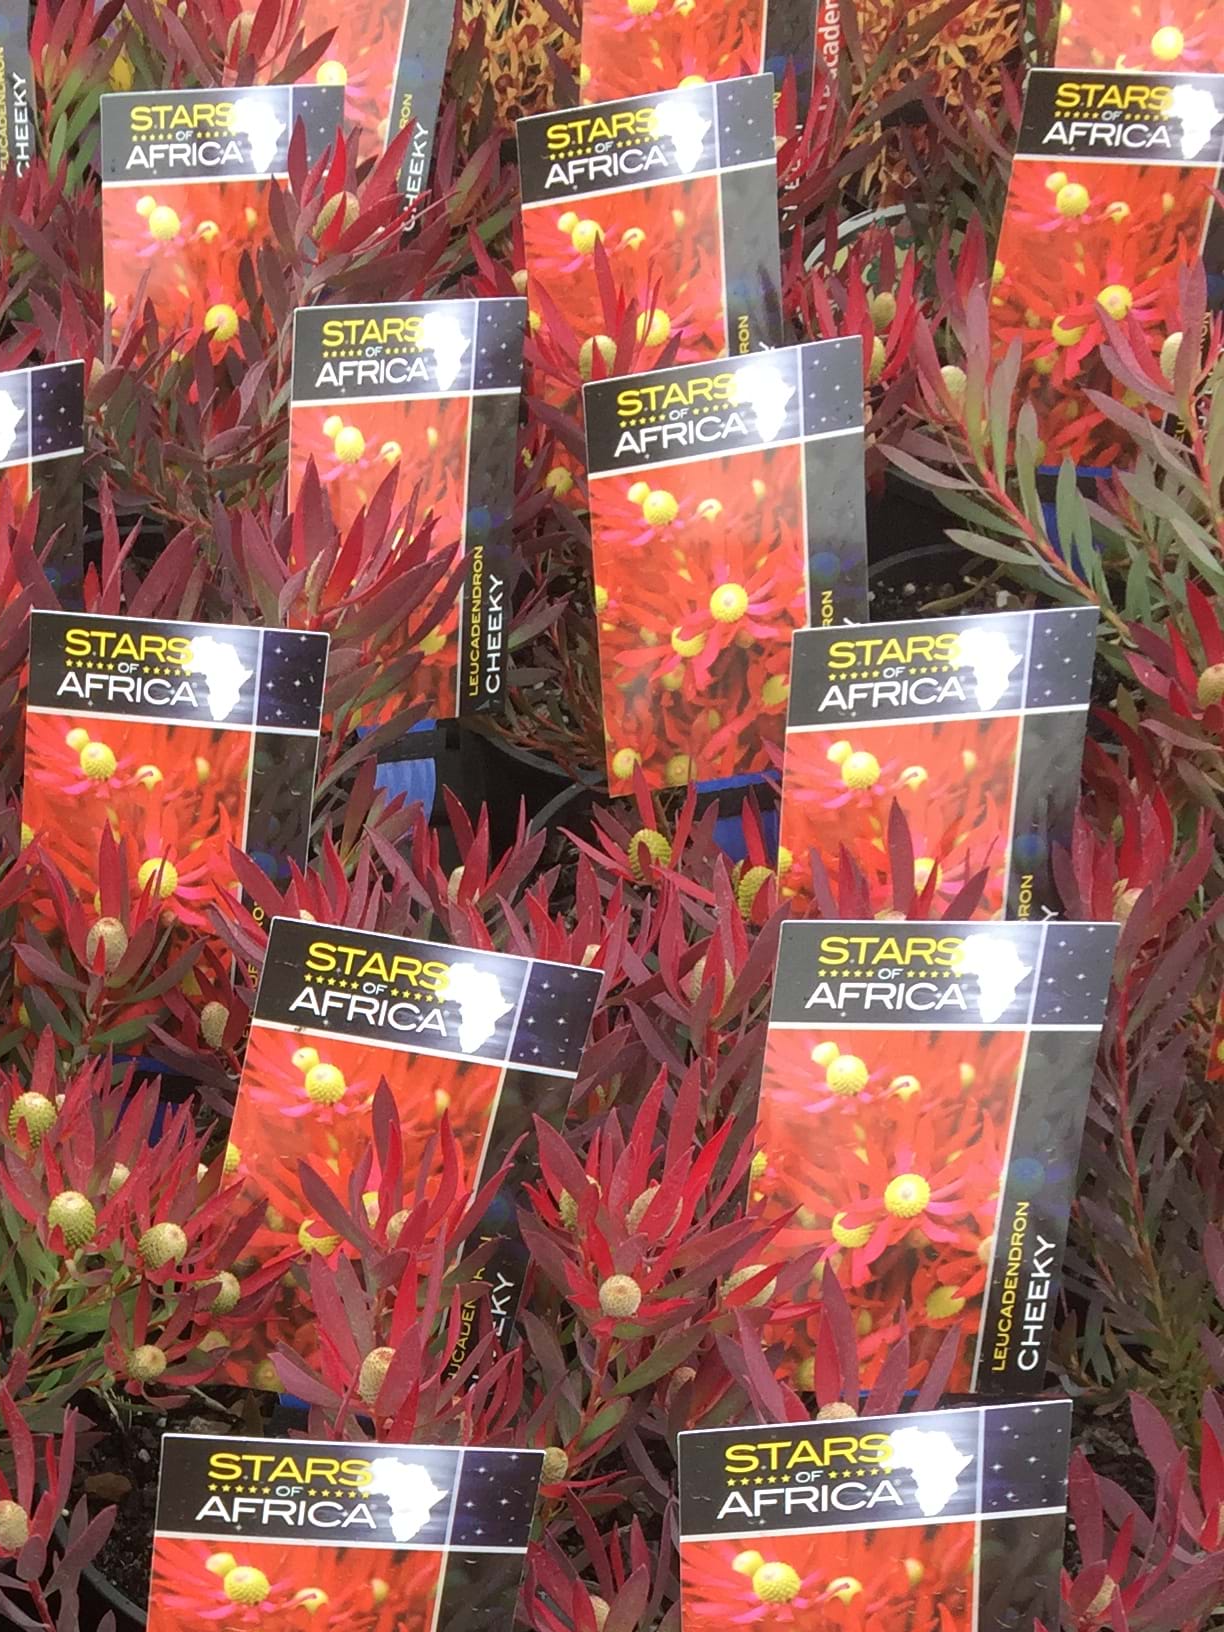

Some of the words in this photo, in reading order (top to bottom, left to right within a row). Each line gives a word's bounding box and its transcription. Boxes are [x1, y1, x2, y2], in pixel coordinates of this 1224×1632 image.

[1055, 82, 1172, 111] STARS
[131, 104, 233, 130] STARS
[546, 109, 657, 150] STARS
[1102, 111, 1122, 121] OF
[176, 131, 193, 141] OF
[595, 141, 613, 153] OF
[1042, 121, 1170, 147] AFRICA
[126, 141, 243, 169] AFRICA
[545, 147, 666, 189] AFRICA
[323, 318, 422, 346] STARS
[365, 346, 383, 358] OF
[316, 358, 430, 386] AFRICA
[617, 375, 734, 416] STARS
[669, 408, 689, 420] OF
[615, 412, 747, 458] AFRICA
[469, 546, 484, 697] LEUCADENDRON
[486, 574, 504, 694] CHEEKY
[65, 628, 193, 665] STARS
[829, 634, 960, 668] STARS
[118, 662, 139, 673] OF
[883, 667, 905, 678] OF
[57, 672, 197, 706] AFRICA
[818, 678, 964, 711] AFRICA
[306, 941, 449, 990] STARS
[819, 937, 964, 966] STARS
[363, 982, 387, 994] OF
[878, 968, 903, 979] OF
[805, 982, 966, 1010] AFRICA
[289, 987, 446, 1036] AFRICA
[992, 1201, 1029, 1371] LEUCADENDRON
[1018, 1234, 1056, 1371] CHEEKY
[725, 1434, 892, 1474] STARS
[208, 1452, 372, 1486] STARS
[796, 1470, 823, 1483] OF
[276, 1486, 303, 1496] OF
[717, 1480, 902, 1519] AFRICA
[195, 1496, 376, 1528] AFRICA
